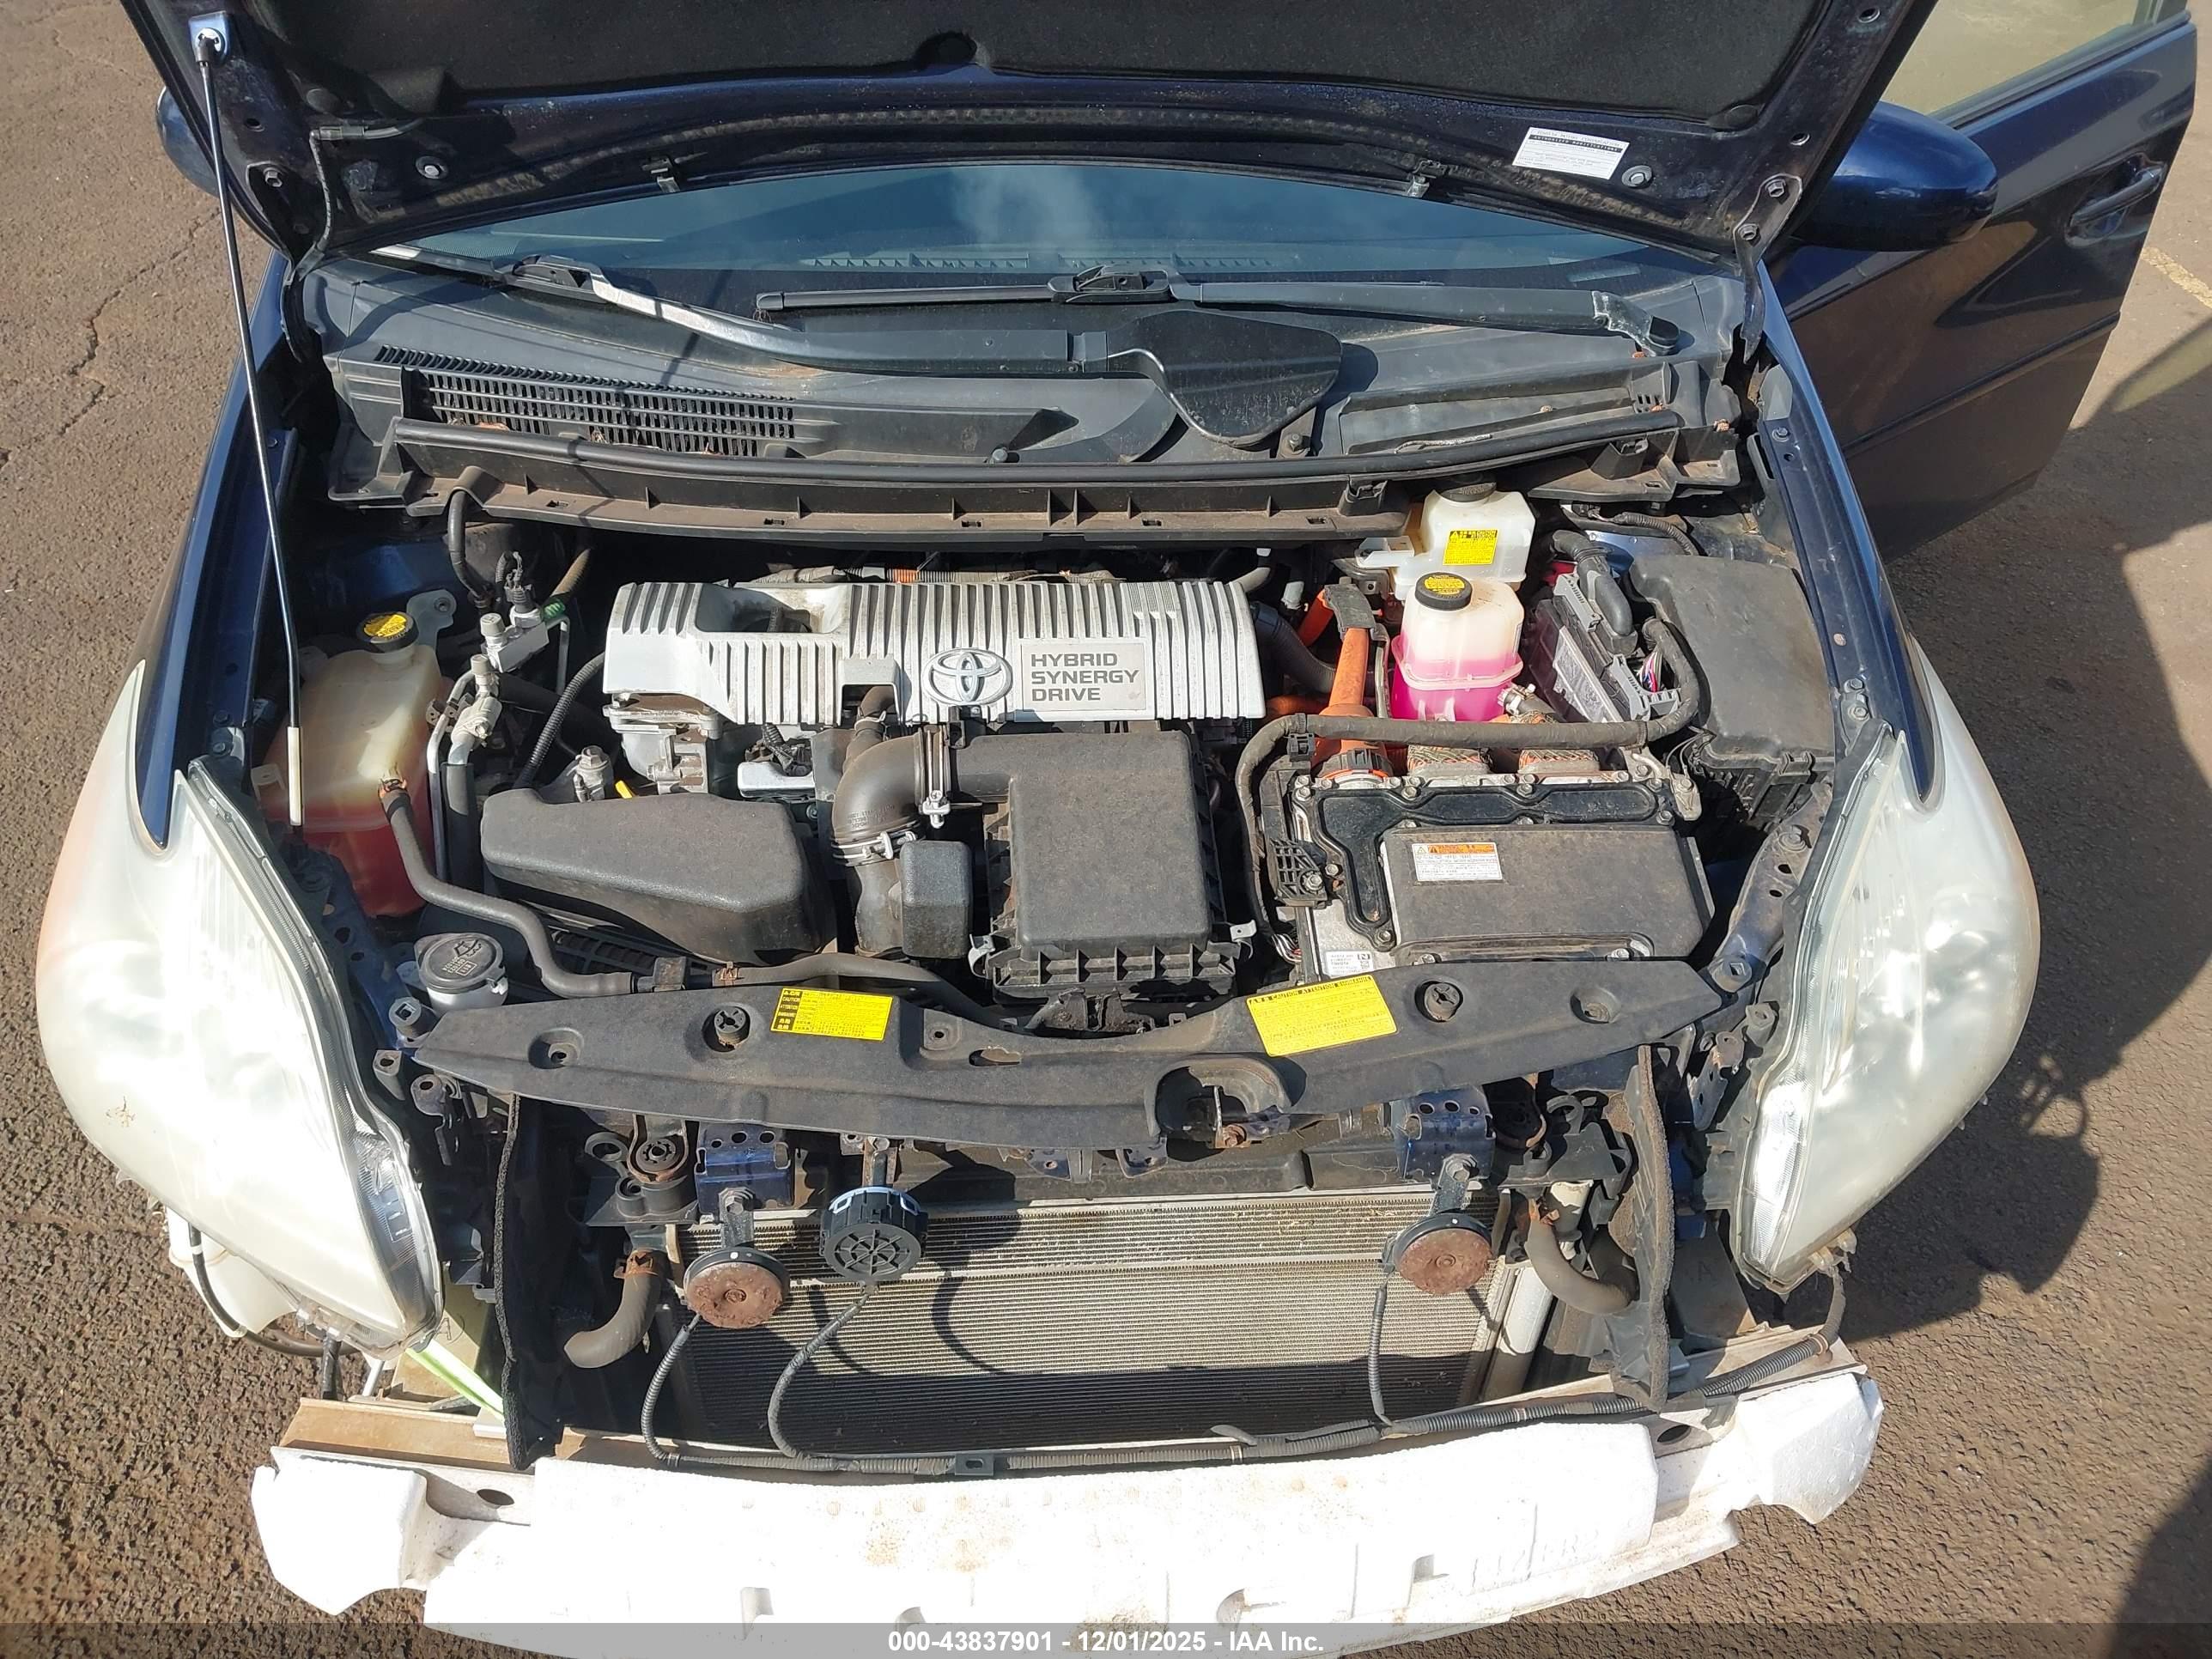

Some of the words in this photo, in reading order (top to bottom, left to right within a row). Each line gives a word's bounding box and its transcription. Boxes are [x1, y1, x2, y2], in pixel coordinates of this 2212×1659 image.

[1031, 653, 1117, 667] HYBRID
[1031, 670, 1139, 684] SYNERGY
[1031, 688, 1101, 702] DRIVE
